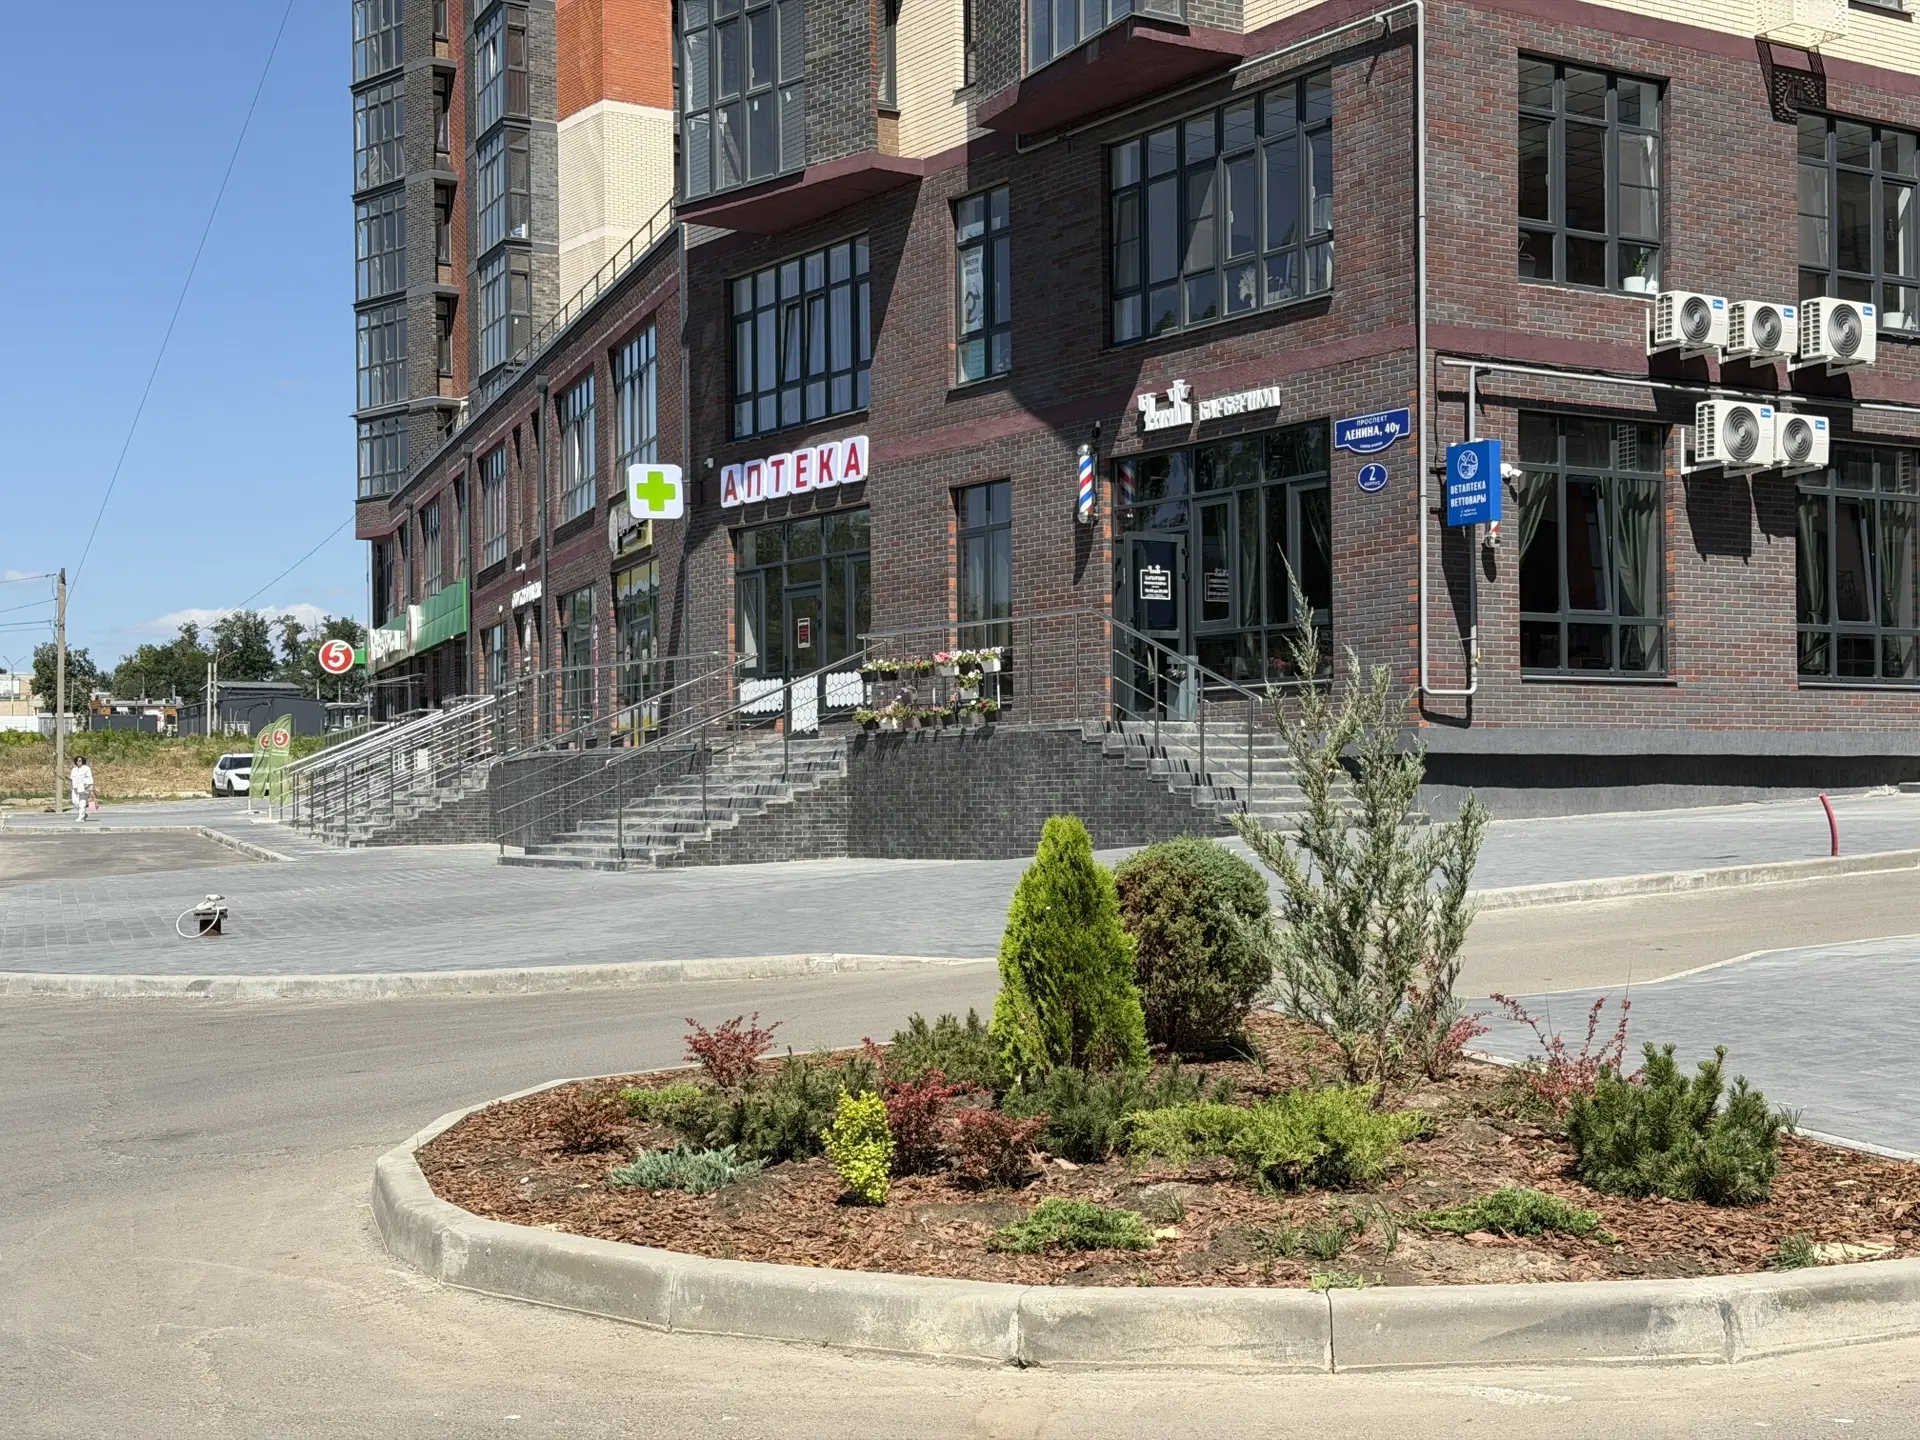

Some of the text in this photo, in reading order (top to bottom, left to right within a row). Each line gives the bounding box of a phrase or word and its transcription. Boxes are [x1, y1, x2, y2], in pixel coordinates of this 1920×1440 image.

[1356, 415, 1388, 427] ПРОСПЕКТ
[1344, 425, 1383, 441] ЛЕНИНА,
[723, 442, 861, 503] АПТЕКА
[1369, 466, 1376, 481] 2
[1450, 480, 1487, 495] ВЕТАПТЕКА
[1450, 493, 1487, 508] ВЕТТОВАРЫ
[327, 641, 348, 668] 5
